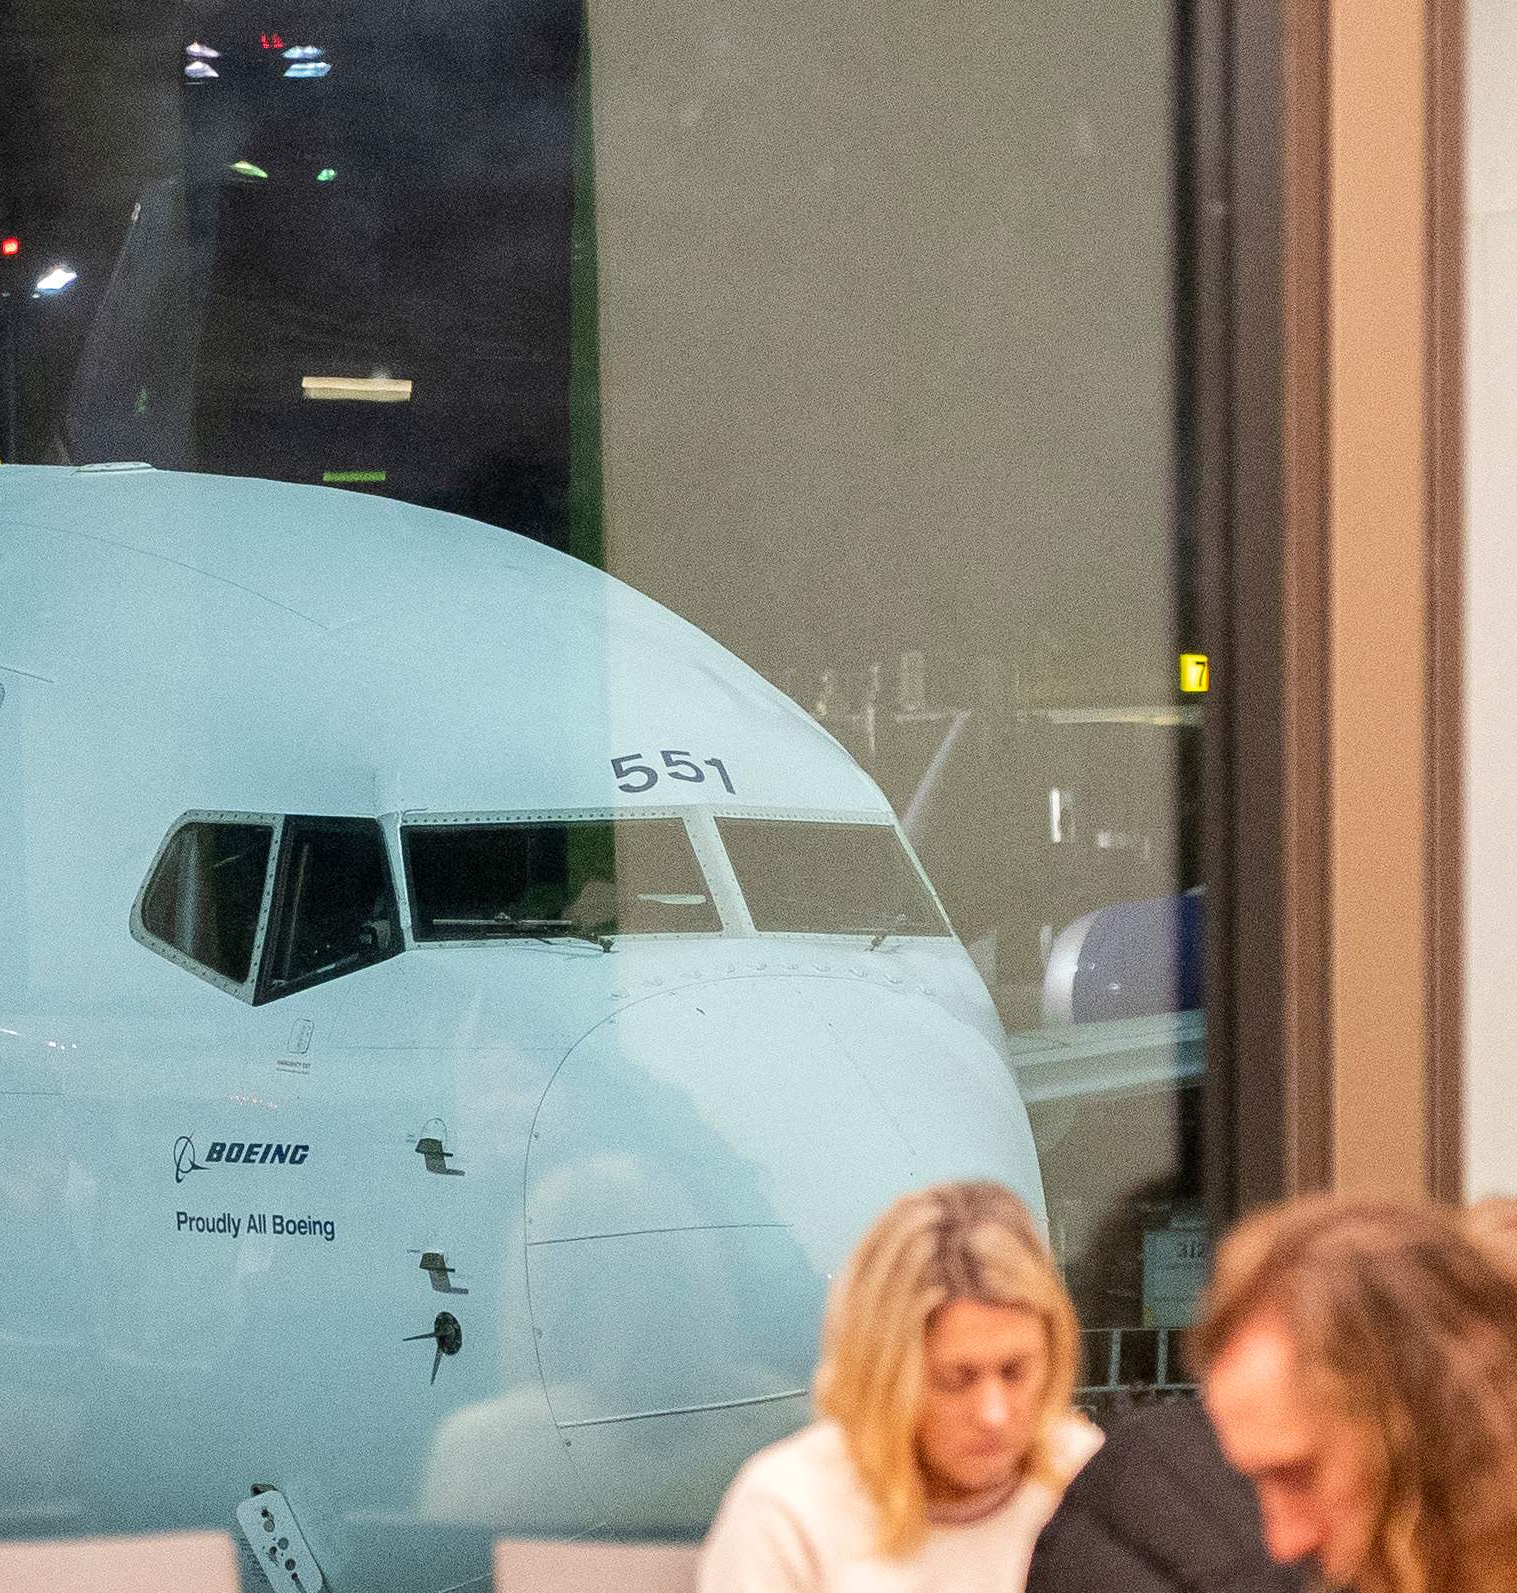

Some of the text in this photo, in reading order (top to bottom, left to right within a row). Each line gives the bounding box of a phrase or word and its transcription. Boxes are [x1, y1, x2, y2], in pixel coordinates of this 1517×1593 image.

[610, 749, 736, 795] 551
[205, 1141, 310, 1165] BOEING
[176, 1211, 335, 1242] Proudly All Boeing
